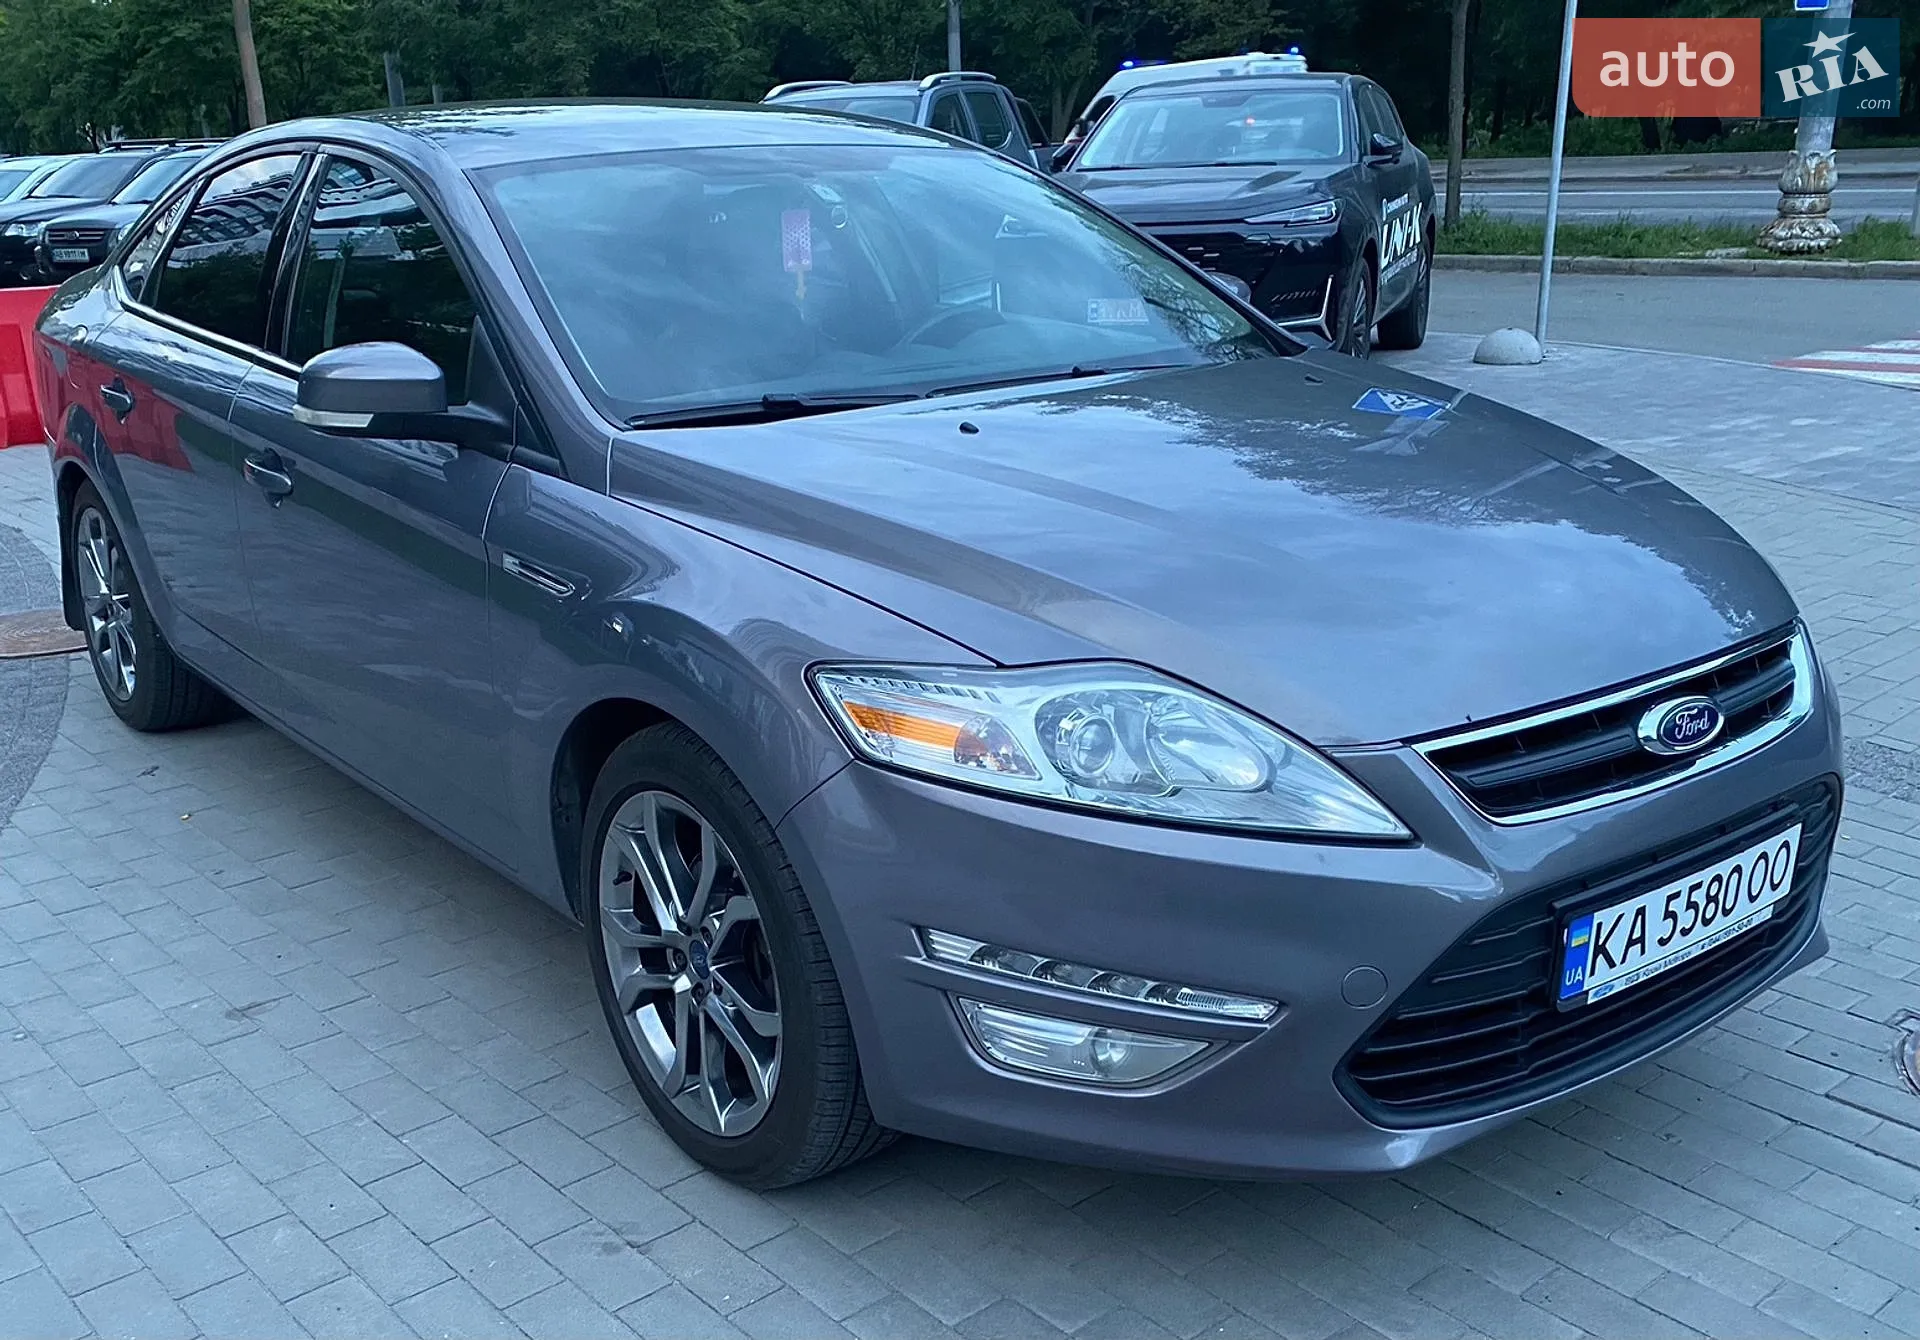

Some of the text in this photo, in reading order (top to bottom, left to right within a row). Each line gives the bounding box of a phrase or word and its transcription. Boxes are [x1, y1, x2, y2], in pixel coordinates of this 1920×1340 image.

[1675, 708, 1710, 739] Ford
[1588, 905, 1647, 978] KA
[1657, 863, 1743, 947] 5580
[1565, 965, 1584, 986] UA
